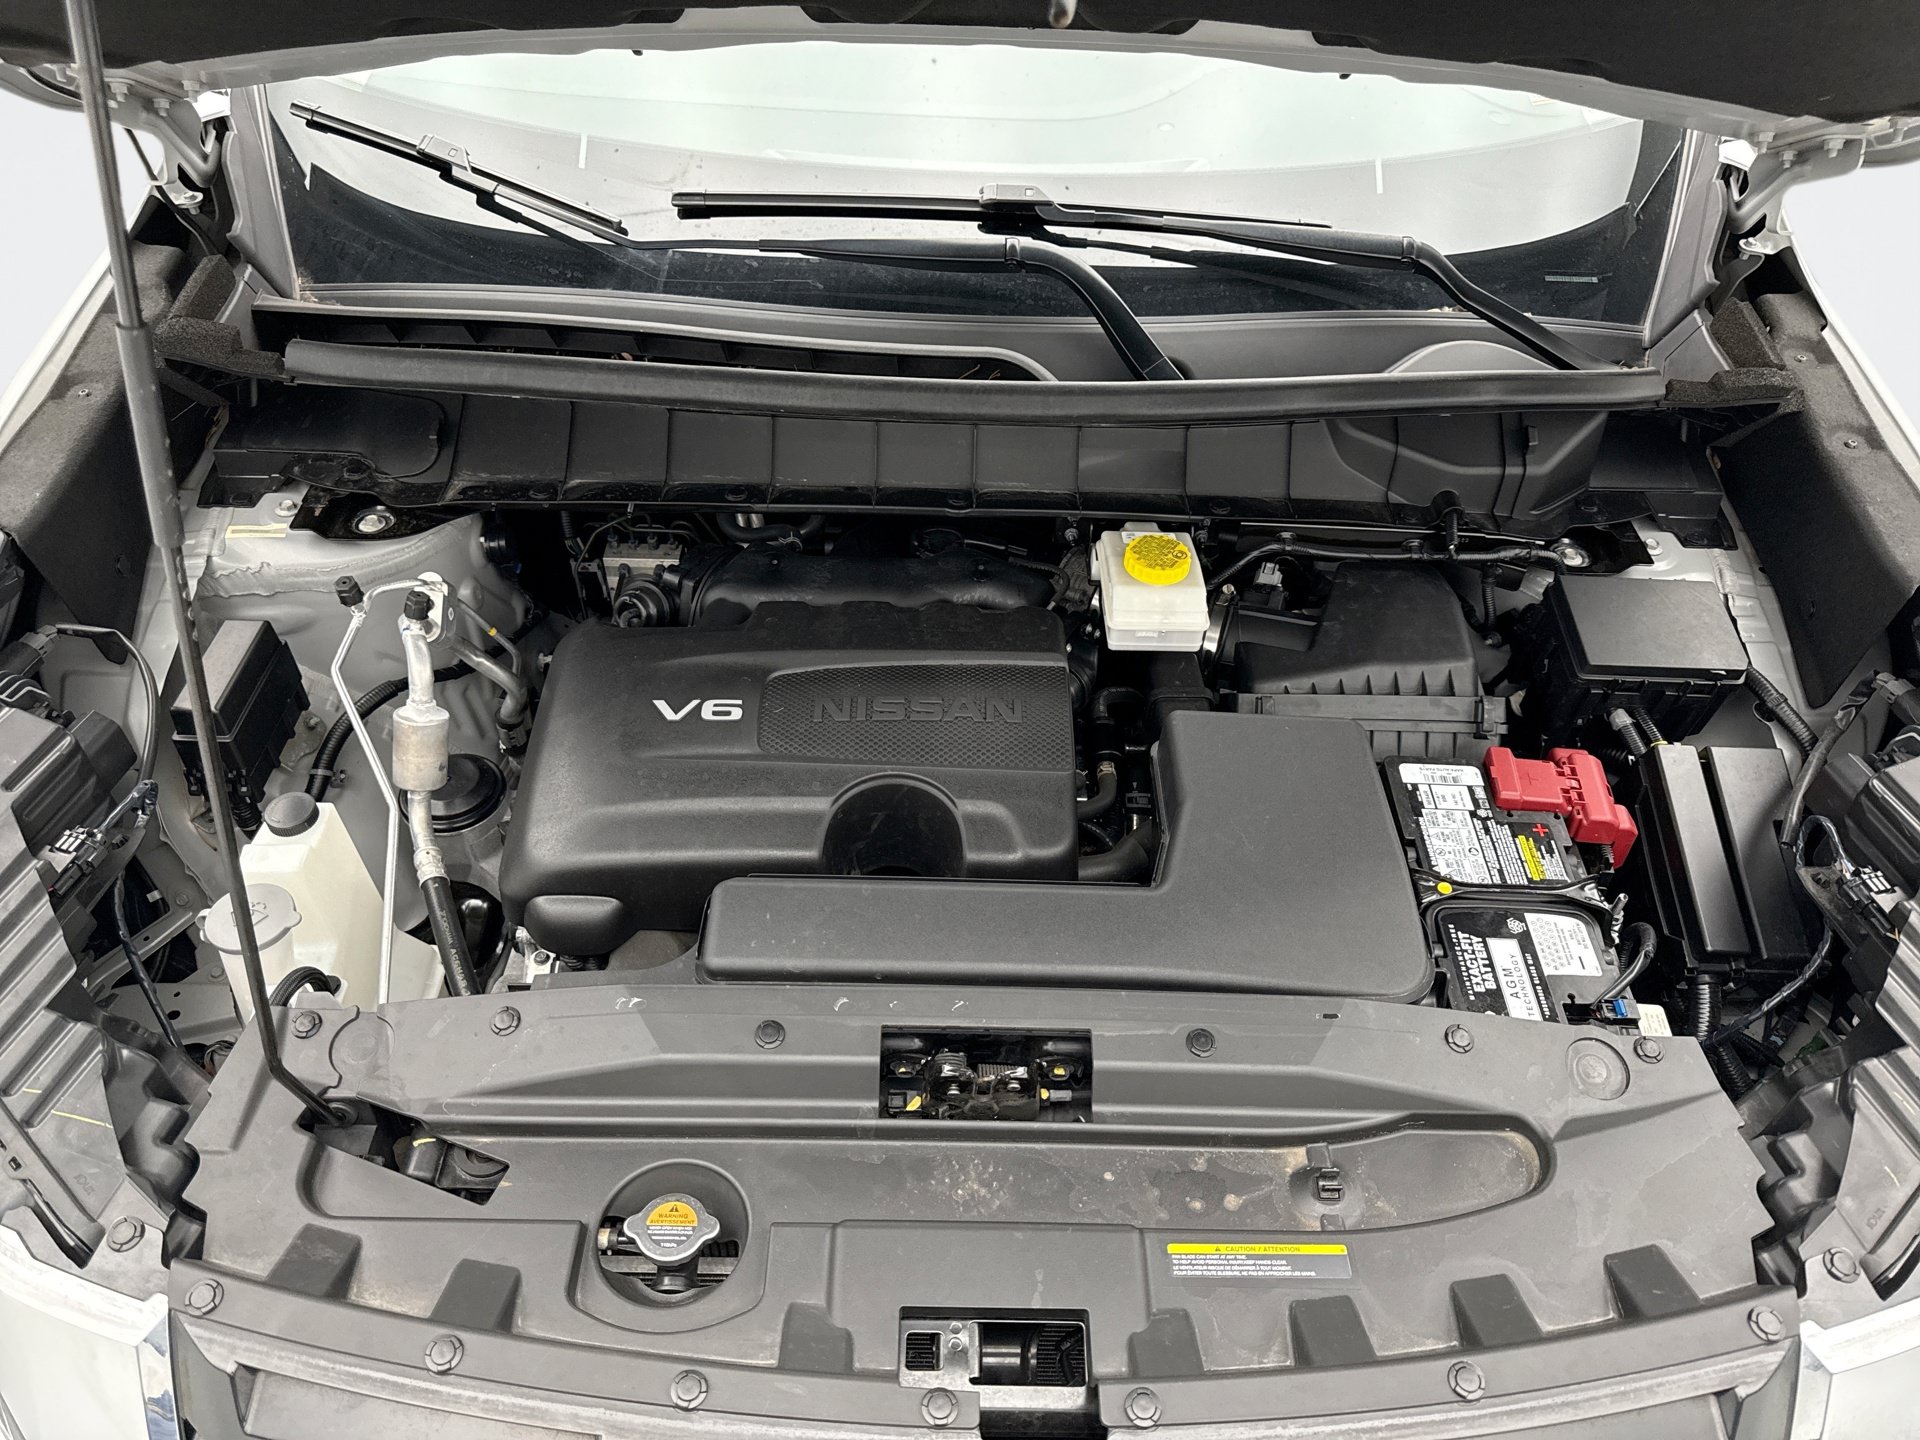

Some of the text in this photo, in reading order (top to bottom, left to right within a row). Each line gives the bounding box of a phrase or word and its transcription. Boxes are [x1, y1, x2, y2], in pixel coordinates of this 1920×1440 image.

[652, 699, 743, 721] V6
[813, 697, 1024, 722] NISSAN
[1448, 924, 1476, 1000] MAINTENANCE-FREE
[1457, 931, 1486, 992] EXACT-FIT
[1470, 934, 1497, 990] BATTERY
[1524, 953, 1534, 964] MAT
[1502, 967, 1521, 1000] AGM
[1510, 953, 1535, 1017] TECHNOLOGY
